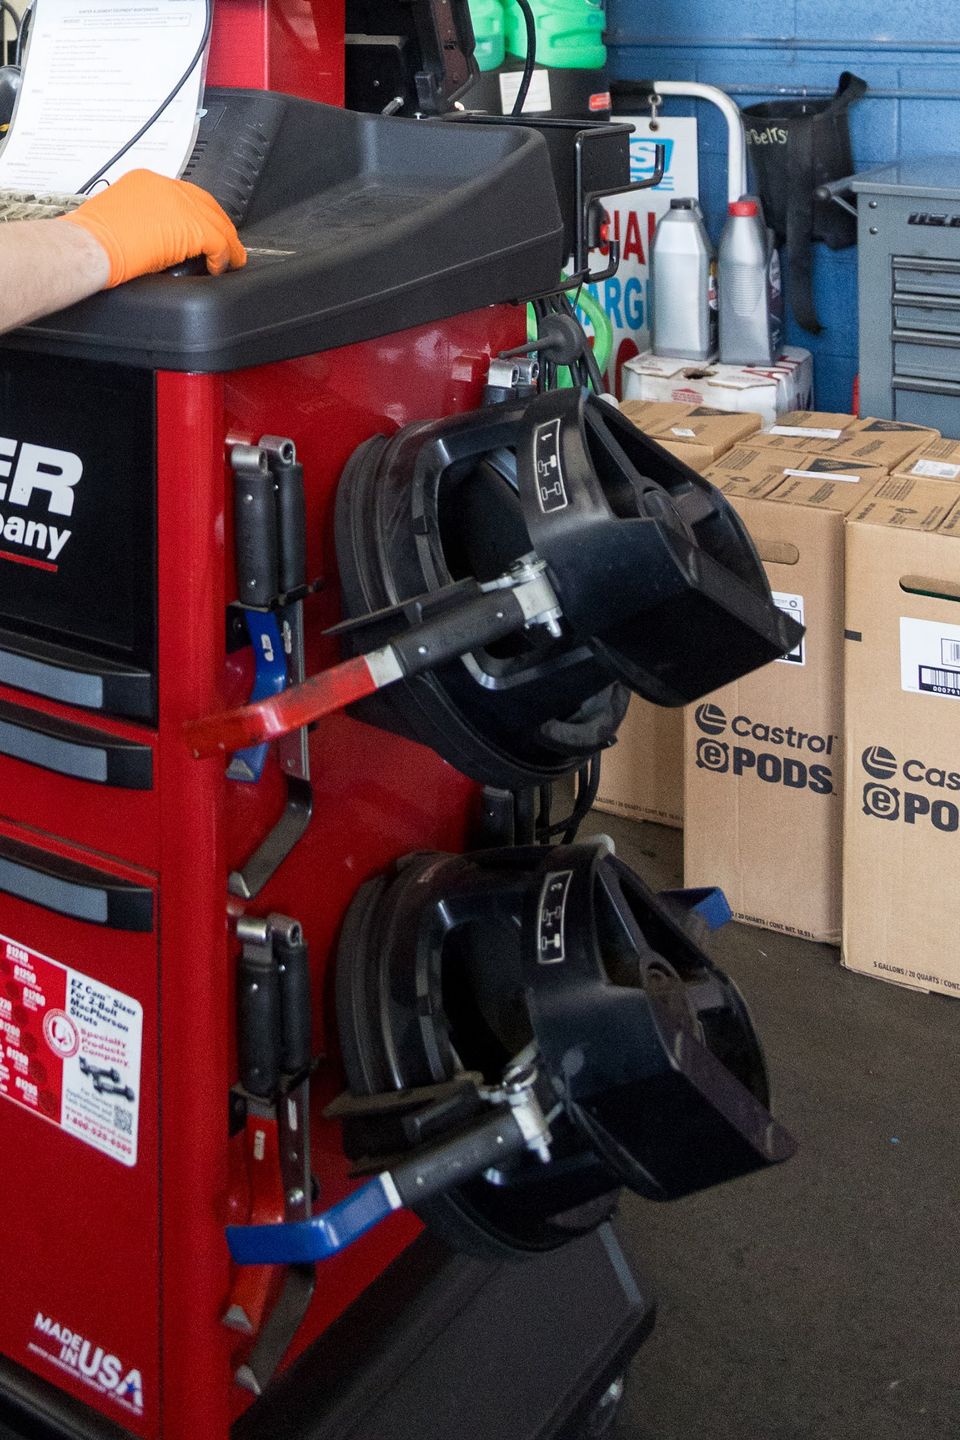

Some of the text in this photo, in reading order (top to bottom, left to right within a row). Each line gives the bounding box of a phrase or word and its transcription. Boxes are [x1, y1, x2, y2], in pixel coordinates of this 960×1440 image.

[732, 715, 834, 755] Castrol
[903, 759, 960, 788] Cas
[70, 998, 129, 1032] MacPherson
[71, 988, 118, 1016] For 2-Bolt
[113, 999, 136, 1016] Sizer
[70, 1007, 98, 1026] Struts
[81, 1028, 127, 1048] Specialty
[81, 1038, 126, 1057] Products
[82, 1046, 129, 1066] Company
[34, 1312, 83, 1350] MADE
[60, 1345, 79, 1367] IN
[79, 1340, 144, 1408] USA
